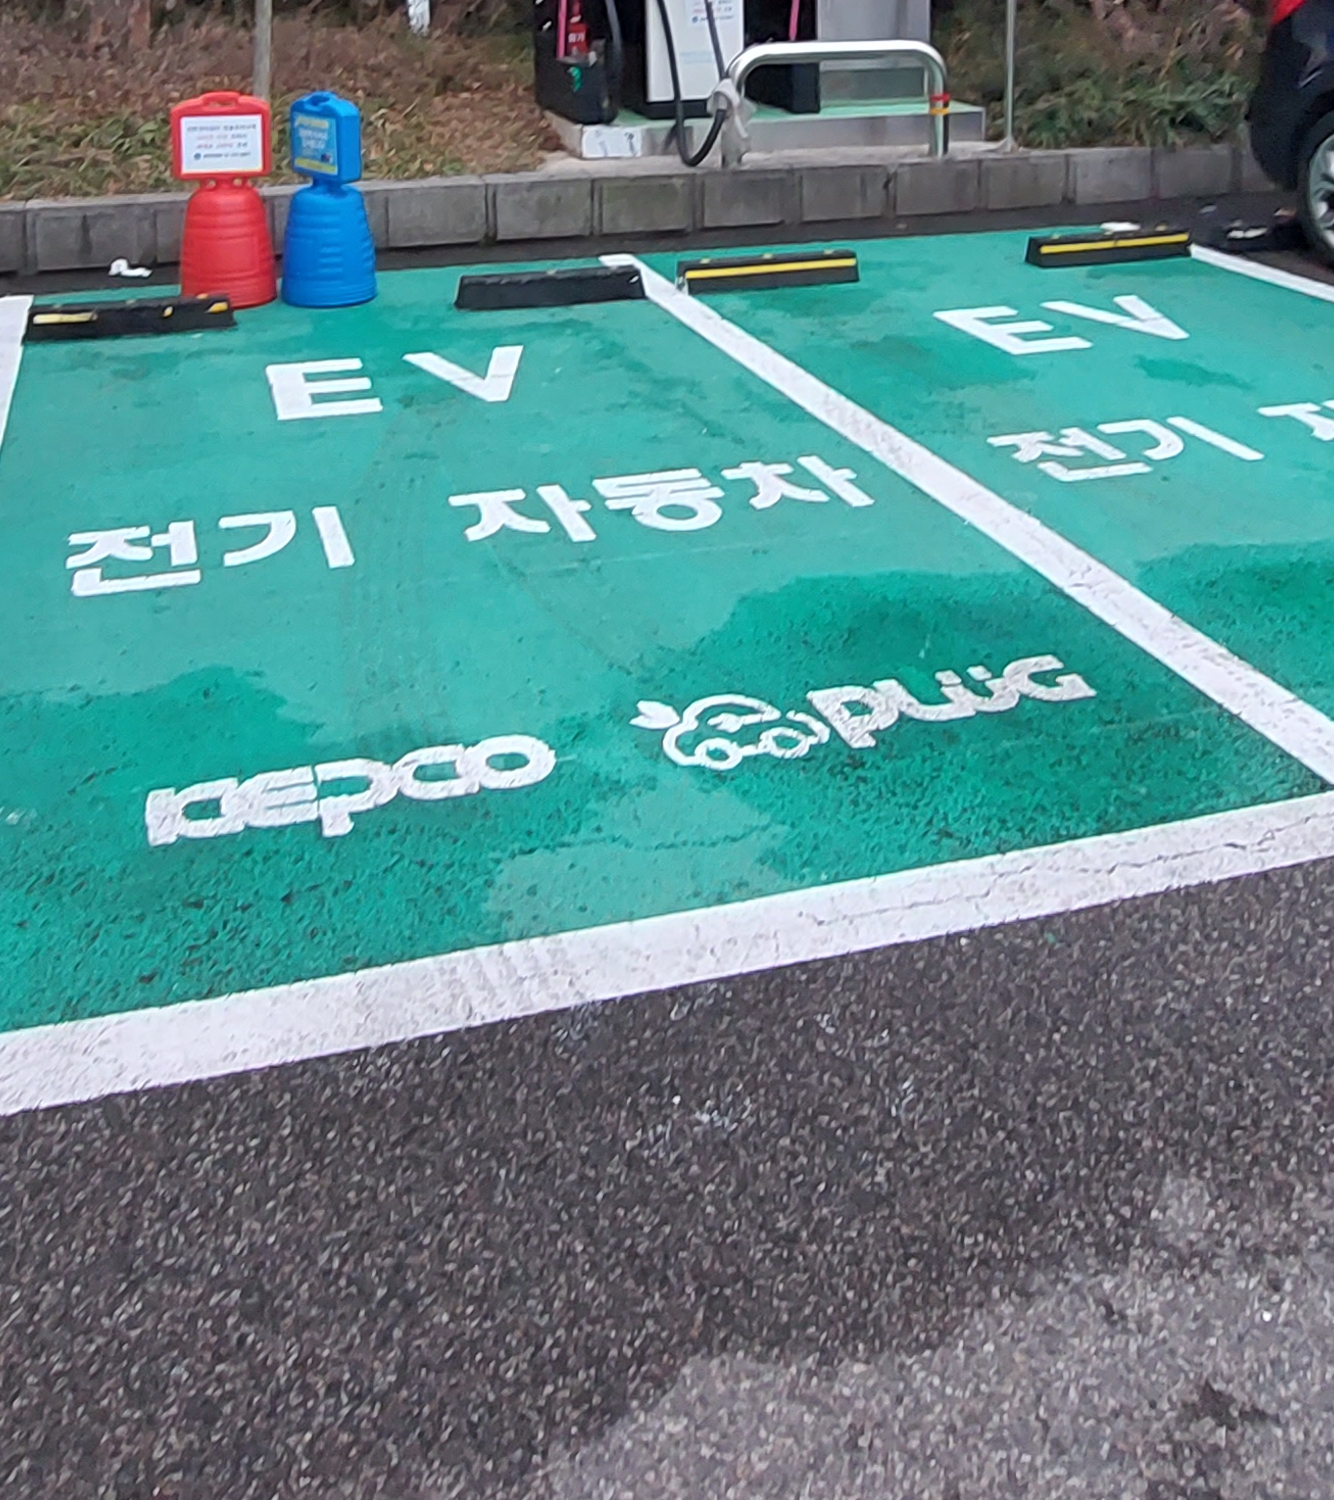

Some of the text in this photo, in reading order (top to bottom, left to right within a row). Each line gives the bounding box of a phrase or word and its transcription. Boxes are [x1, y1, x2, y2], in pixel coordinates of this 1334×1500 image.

[932, 295, 1190, 355] EV
[265, 346, 523, 420] EV
[987, 416, 1265, 482] 전기
[66, 455, 875, 597] 전기 자동차
